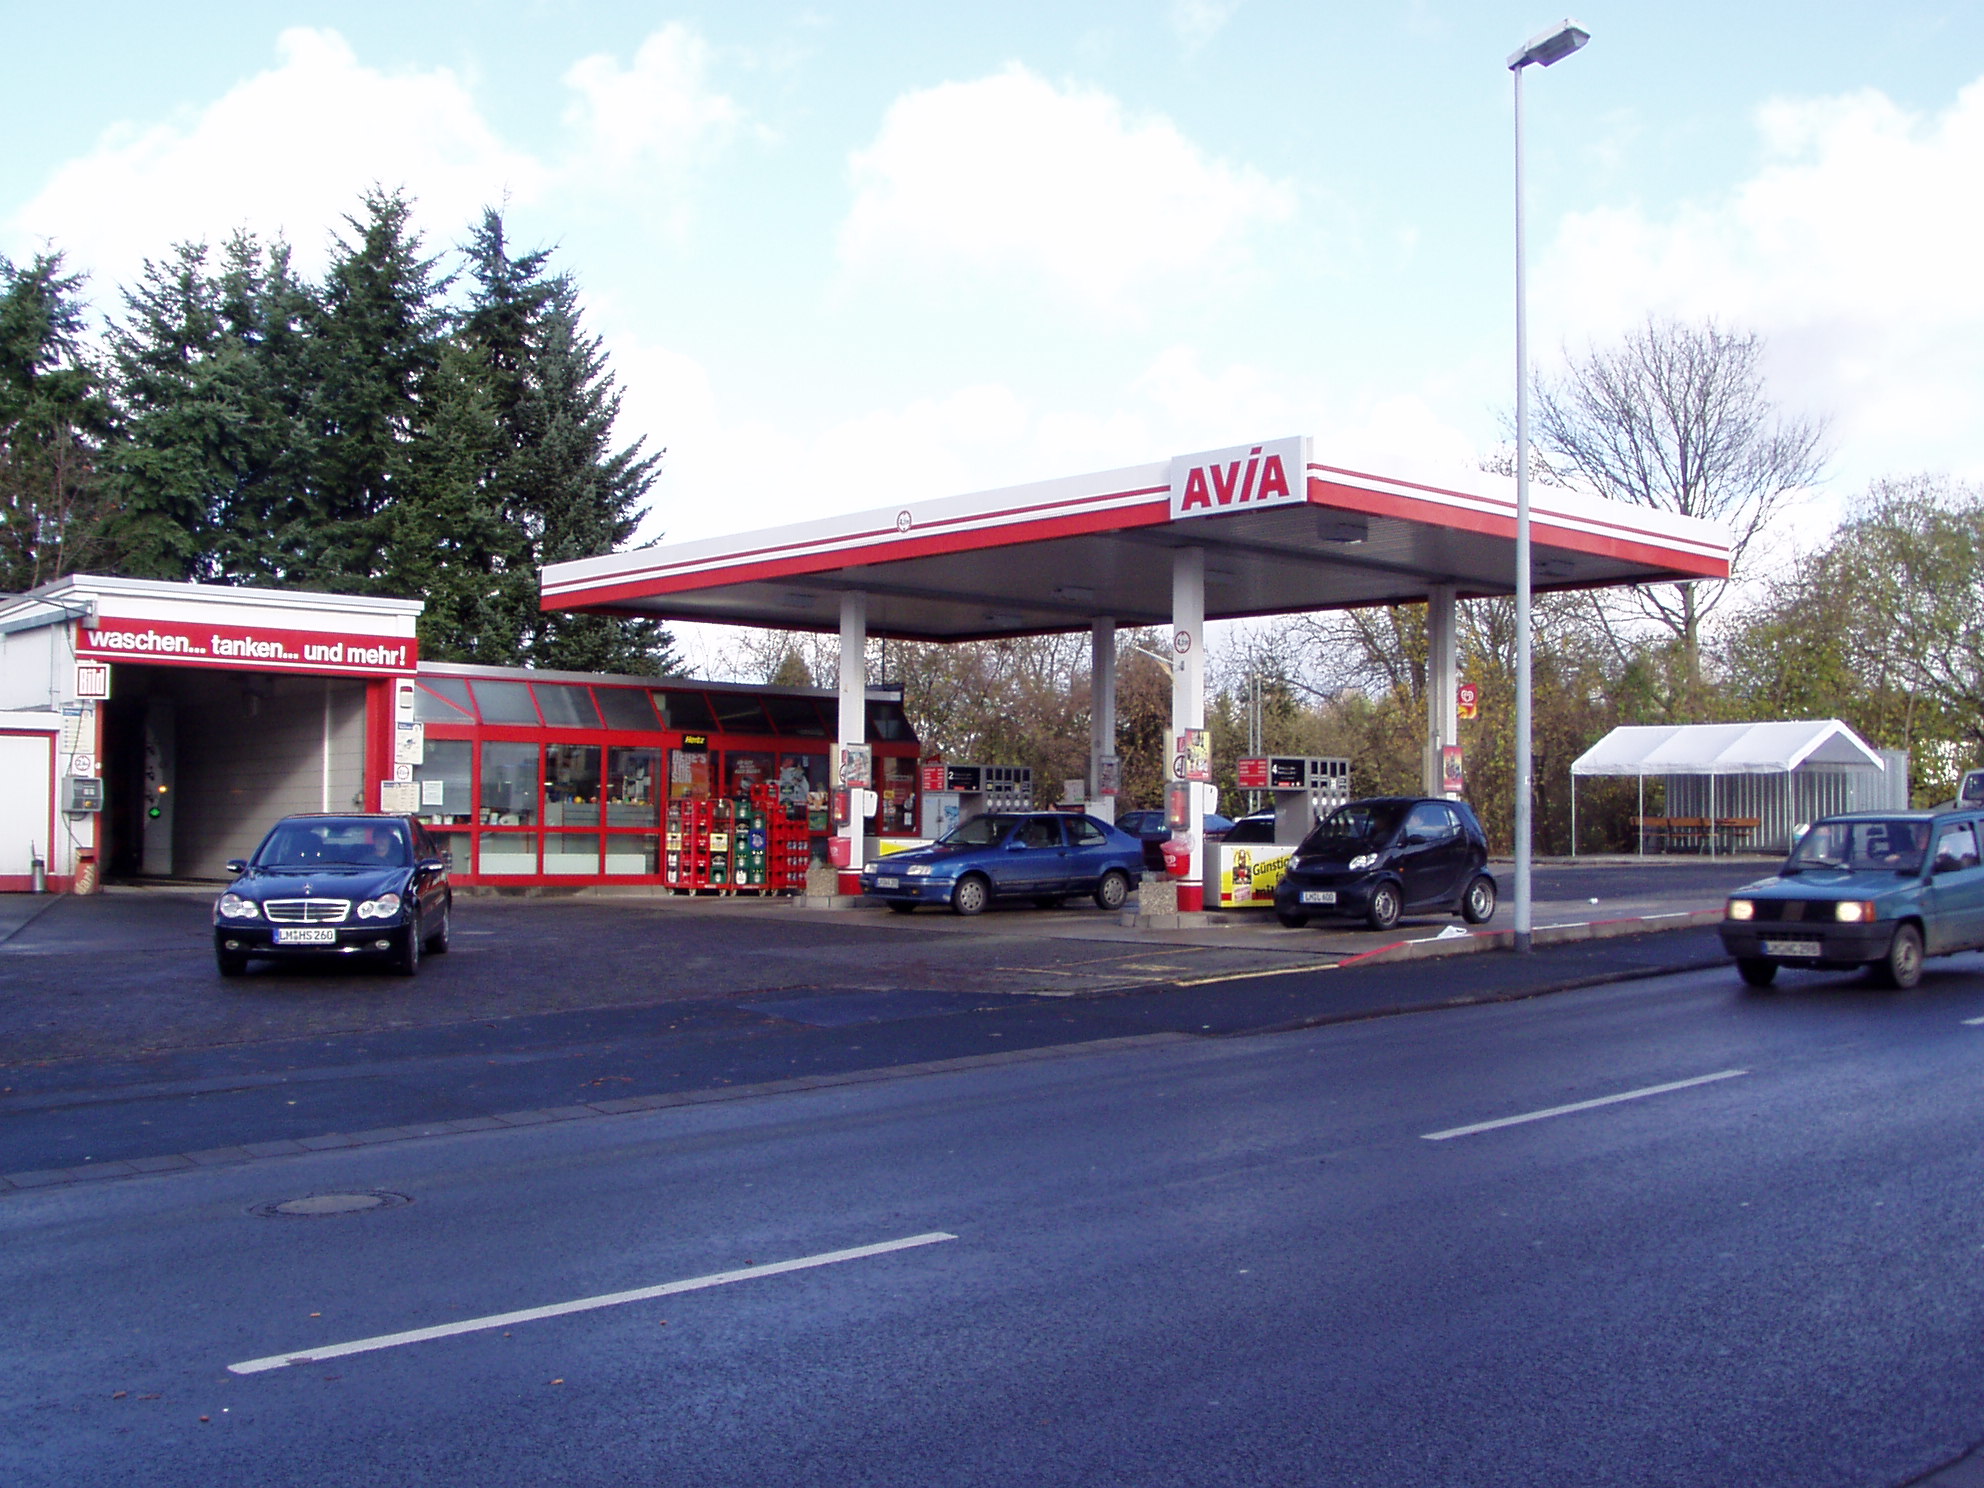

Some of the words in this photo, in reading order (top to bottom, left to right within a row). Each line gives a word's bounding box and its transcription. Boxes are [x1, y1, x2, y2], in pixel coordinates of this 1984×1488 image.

[1181, 446, 1290, 511] AVIA
[88, 630, 206, 654] waschen...
[211, 634, 299, 660] tanken...
[304, 642, 343, 663] und
[347, 645, 406, 666] mehr!
[78, 668, 105, 695] Bild
[685, 735, 705, 744] Hertz
[1272, 764, 1278, 774] 4
[948, 771, 954, 780] 2
[314, 930, 333, 940] 260
